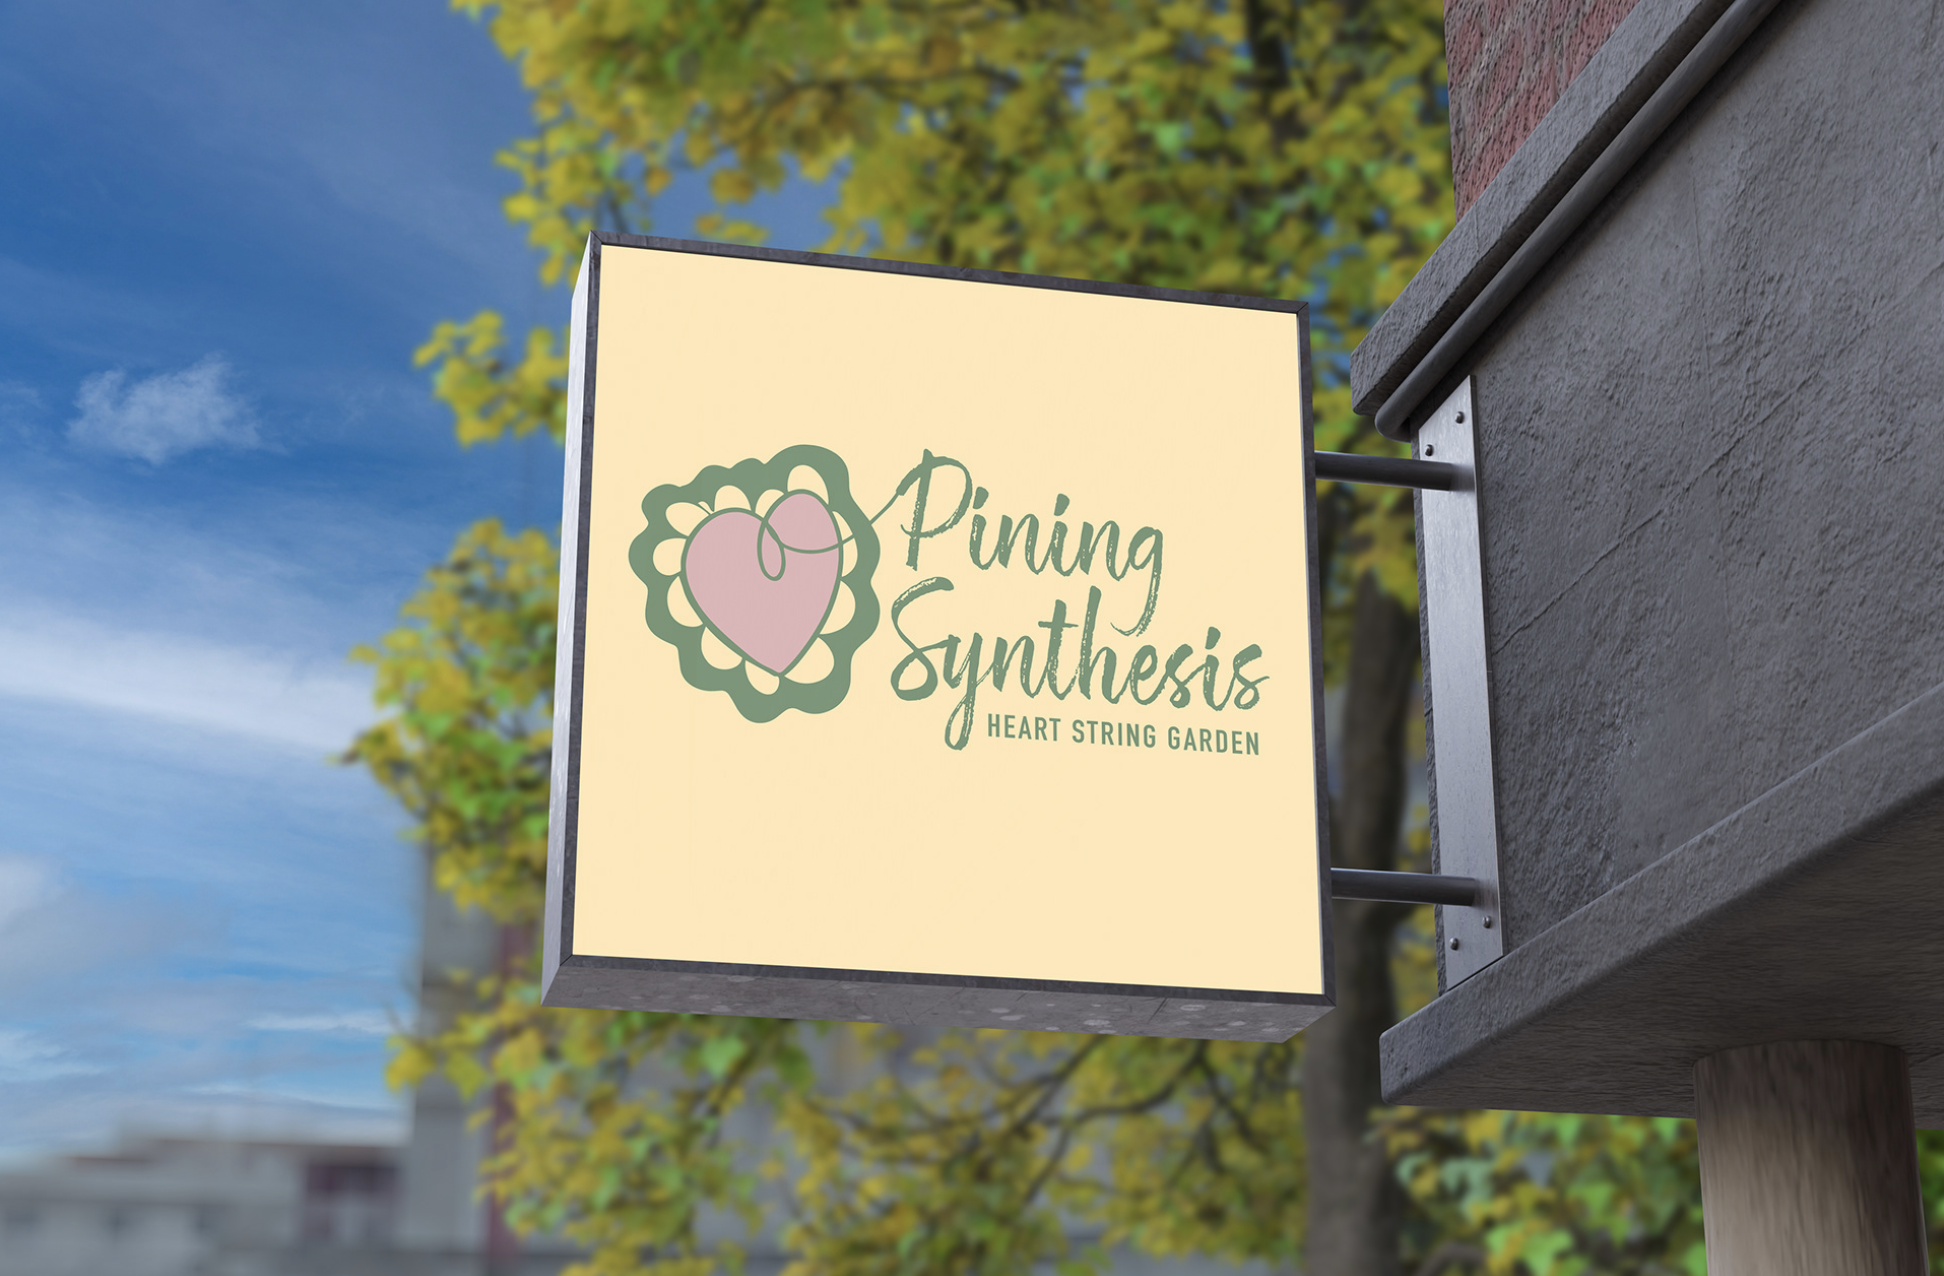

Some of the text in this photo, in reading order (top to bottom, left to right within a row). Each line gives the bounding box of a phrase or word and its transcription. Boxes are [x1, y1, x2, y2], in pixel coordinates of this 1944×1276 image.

[896, 448, 1164, 638] Pining
[890, 576, 1270, 751] Synthesis
[987, 713, 1259, 756] HEART STRING GARDEN
